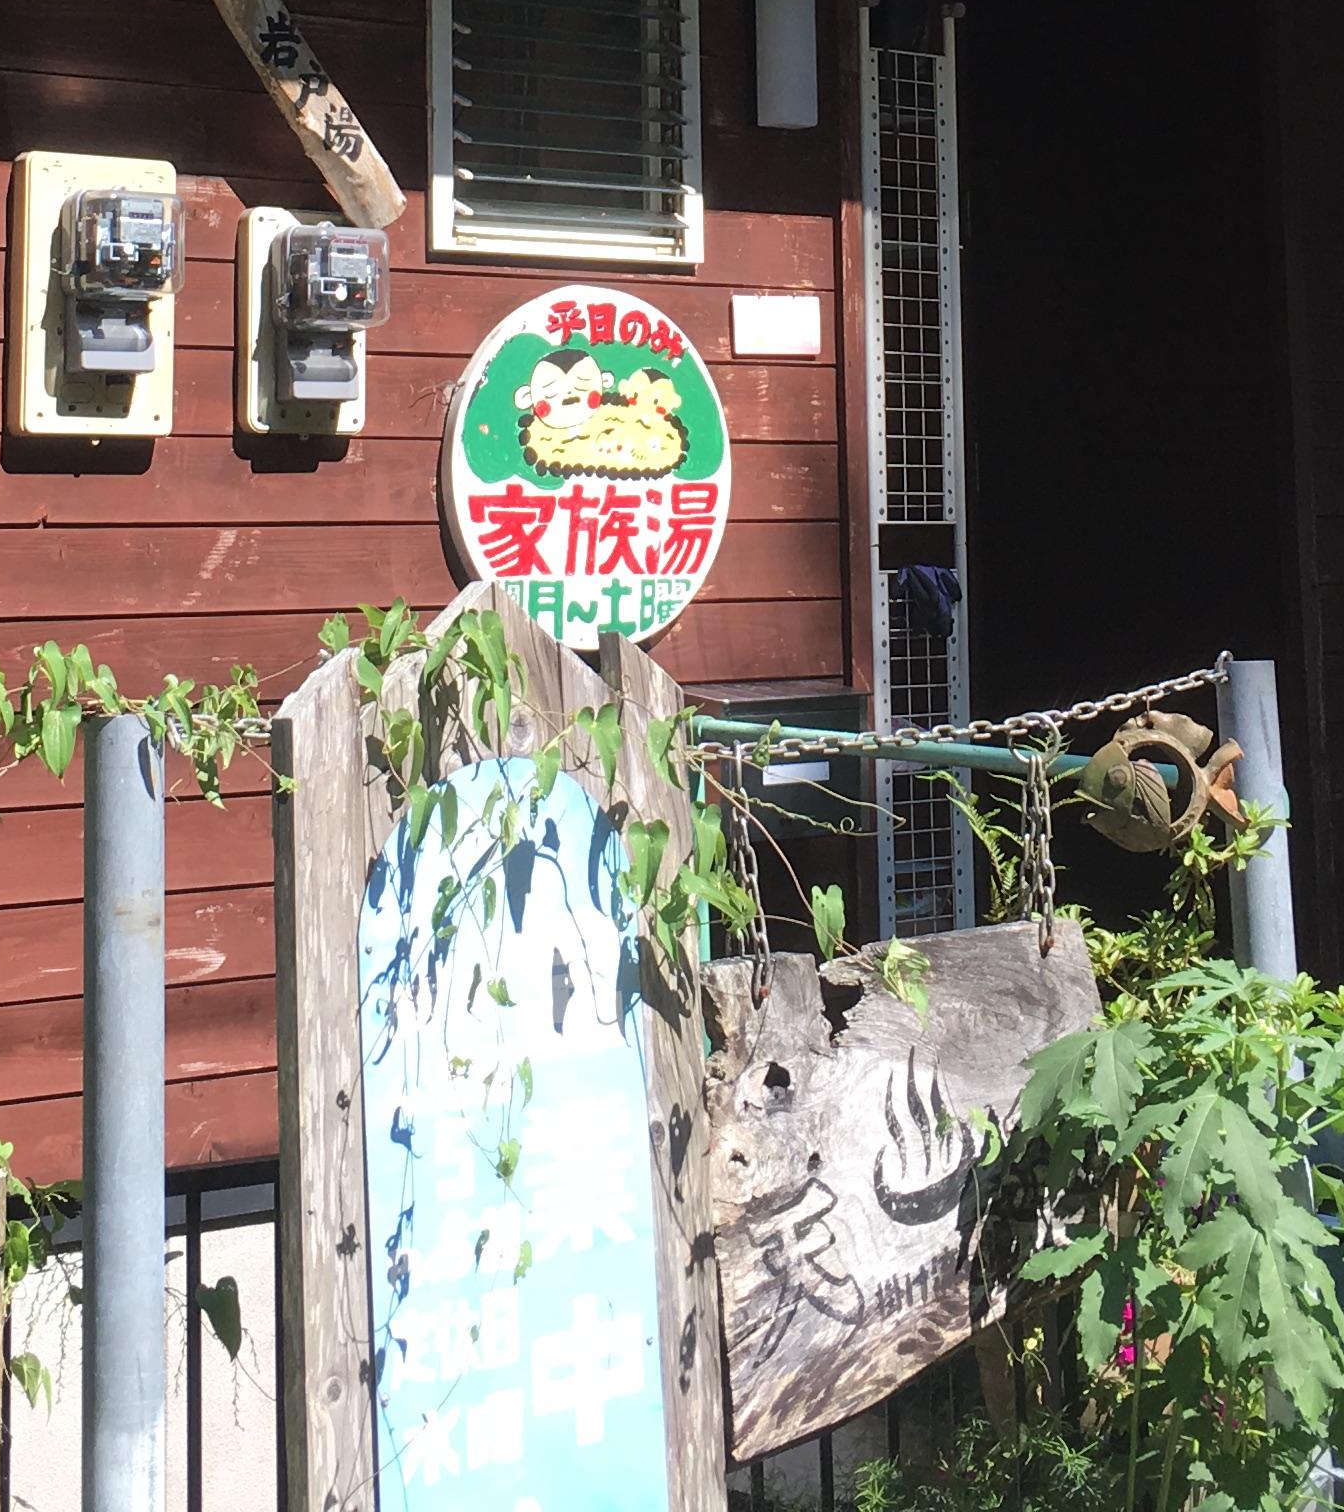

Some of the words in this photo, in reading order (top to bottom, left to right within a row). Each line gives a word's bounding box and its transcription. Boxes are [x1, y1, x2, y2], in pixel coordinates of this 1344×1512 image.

[259, 10, 364, 163] 岩戸湯
[546, 300, 688, 360] 平日のみ
[468, 484, 719, 578] 家族湯
